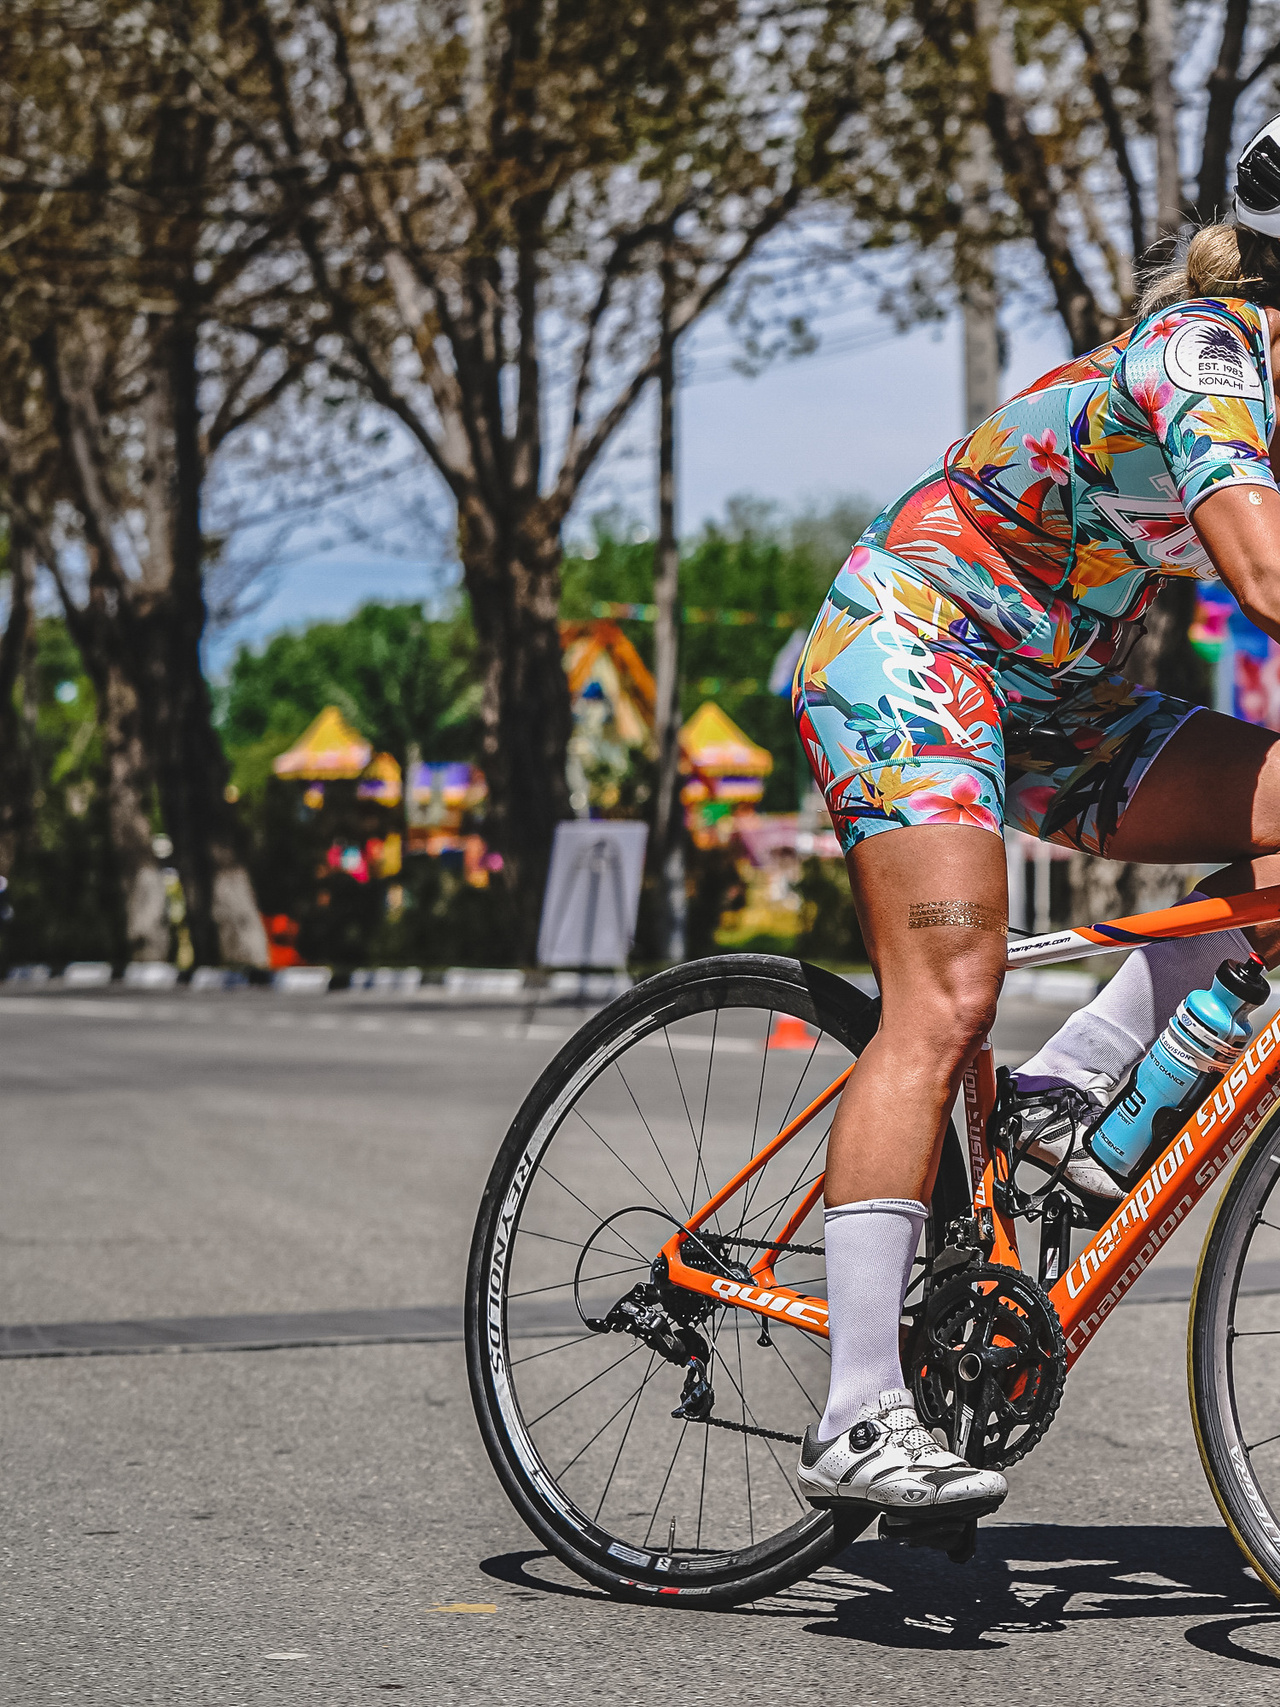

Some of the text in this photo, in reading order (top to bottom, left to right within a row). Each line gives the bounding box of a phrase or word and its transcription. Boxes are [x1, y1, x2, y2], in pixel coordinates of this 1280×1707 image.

[1198, 362, 1244, 378] EST. 1983
[1159, 1065, 1186, 1087] CHANCE
[488, 1150, 533, 1376] REYNOLDS
[1065, 1131, 1195, 1299] Champion
[711, 1278, 829, 1328] QUIC
[1065, 1194, 1193, 1354] Champion
